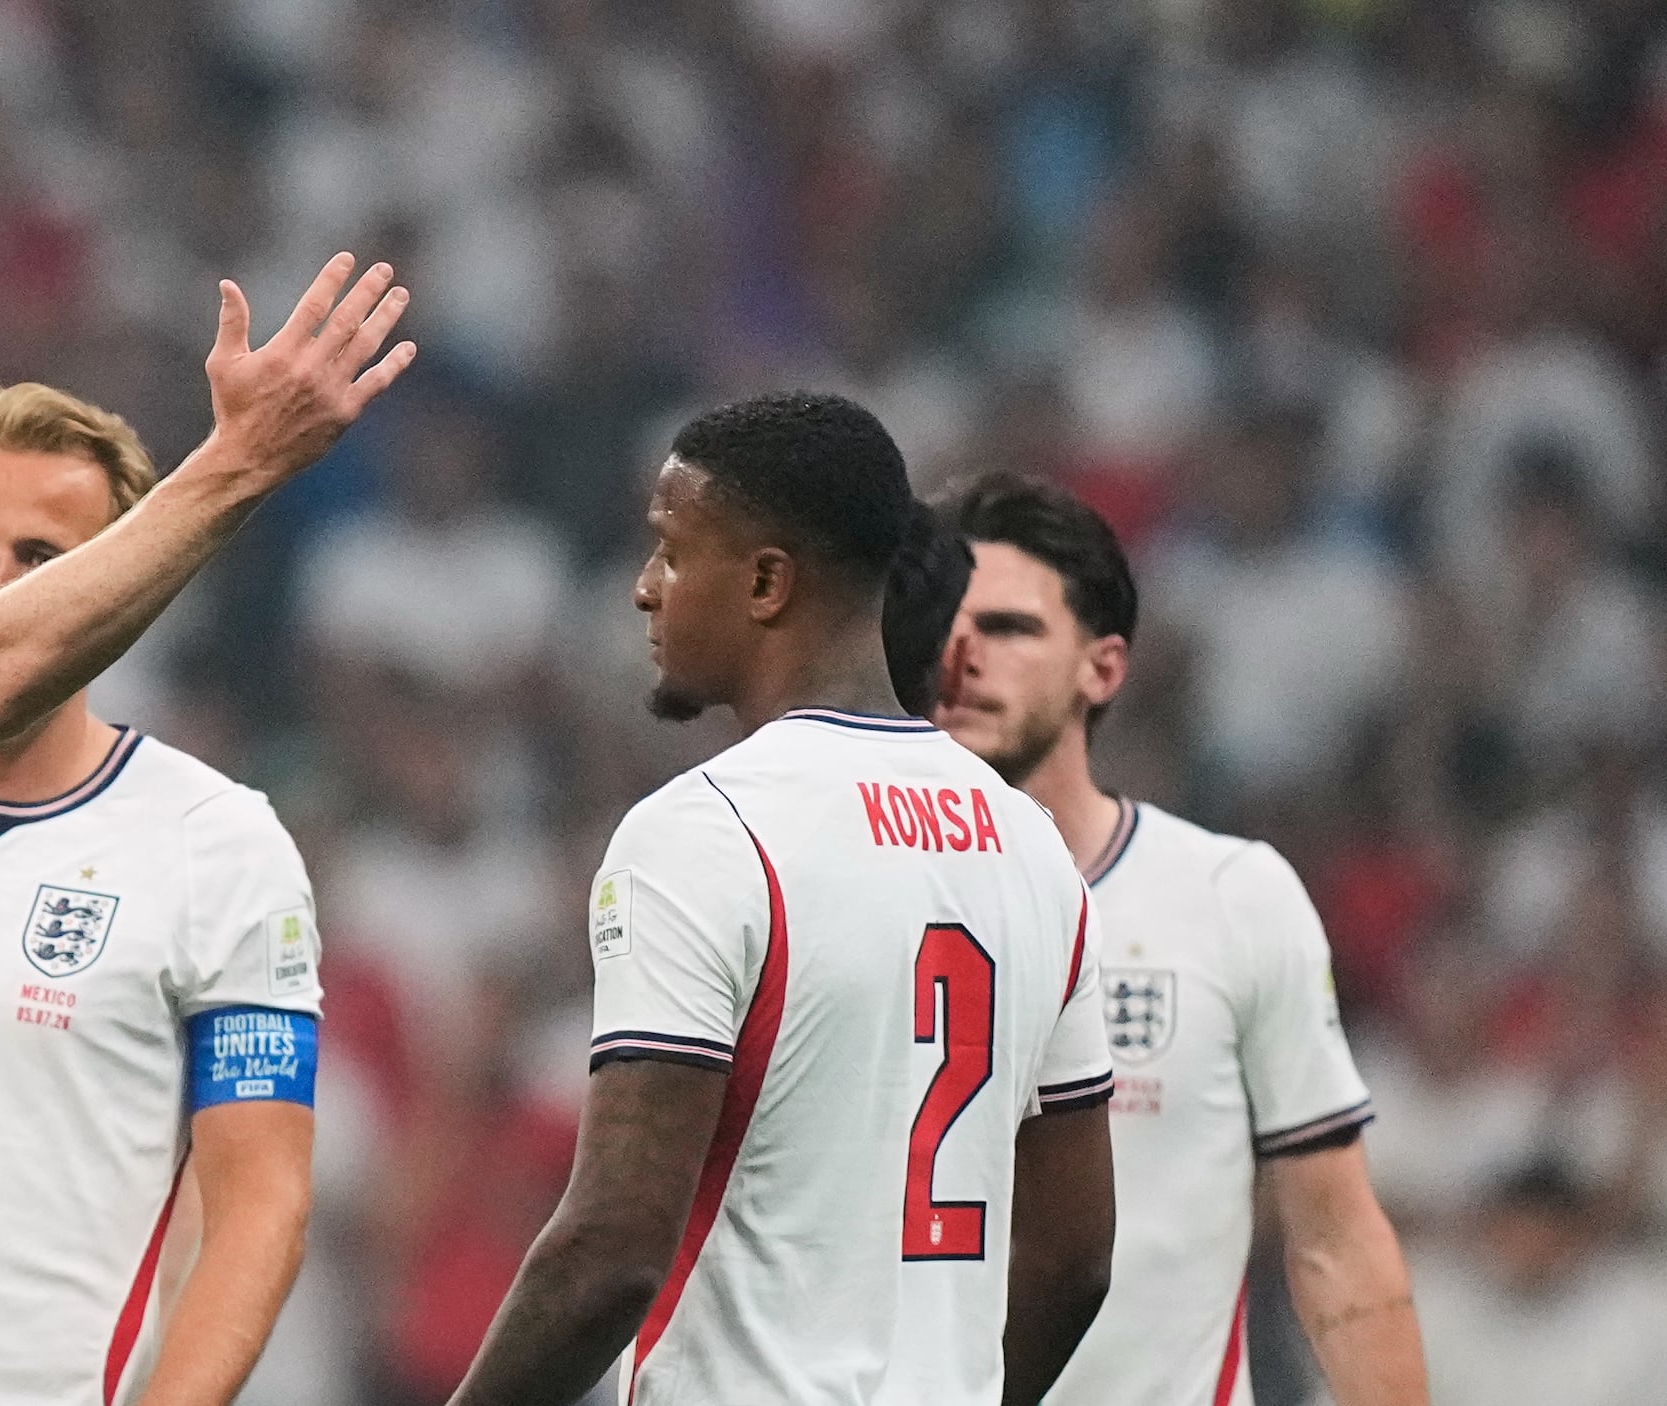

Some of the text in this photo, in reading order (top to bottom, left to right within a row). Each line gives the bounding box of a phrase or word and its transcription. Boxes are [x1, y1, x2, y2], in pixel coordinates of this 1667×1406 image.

[856, 782, 1003, 853] KONSA
[20, 984, 77, 1007] MEXICO
[213, 1012, 294, 1034] FOOTBALL
[213, 1031, 295, 1059] UNITES
[901, 922, 996, 1262] 2
